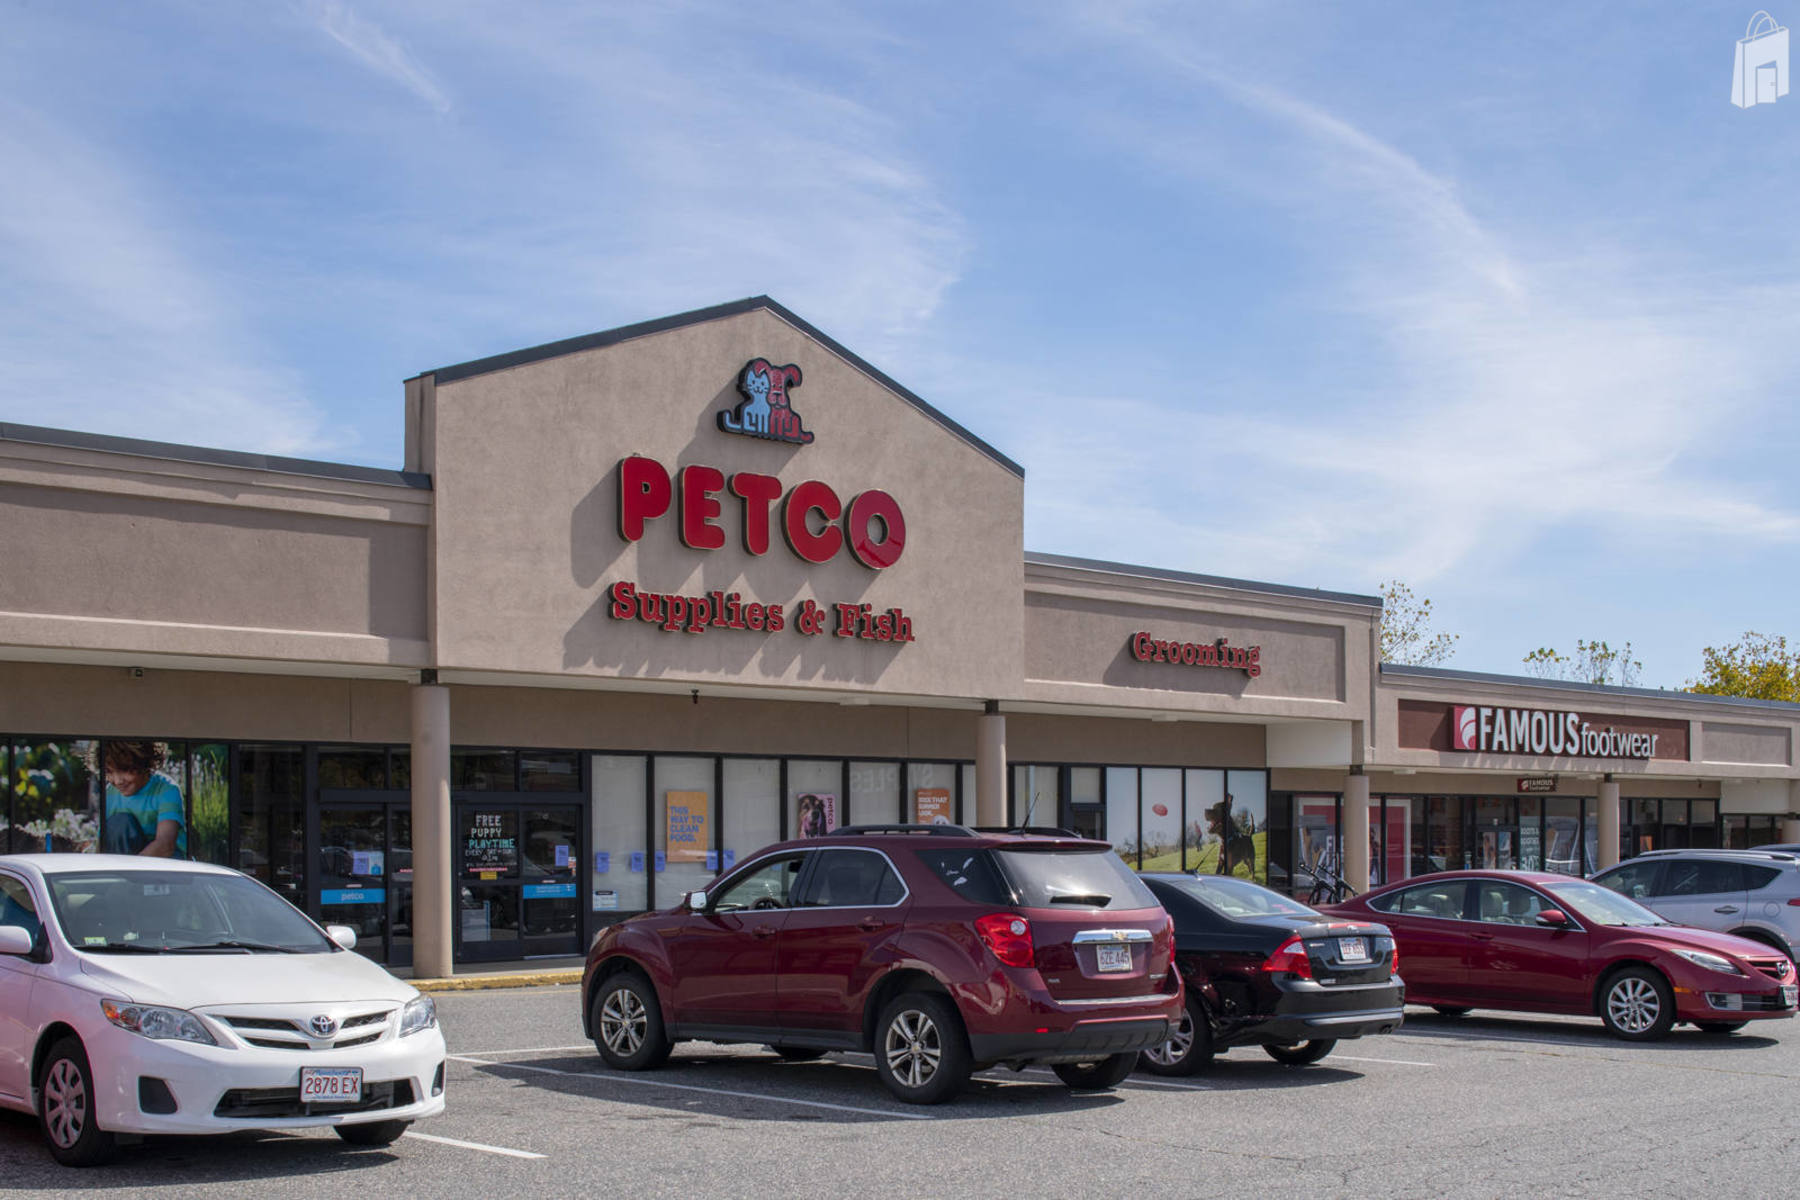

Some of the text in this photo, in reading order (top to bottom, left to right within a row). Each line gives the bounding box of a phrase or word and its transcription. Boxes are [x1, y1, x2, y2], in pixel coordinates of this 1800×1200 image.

[617, 455, 906, 570] PETCO
[608, 580, 916, 643] Supplies & Fish
[1129, 631, 1262, 678] Grooming
[1479, 707, 1659, 757] FAMOUS footwear
[670, 806, 689, 816] THIS
[475, 815, 502, 827] FREE
[670, 815, 704, 824] WAY TO
[471, 828, 502, 838] PUPPY
[670, 824, 699, 833] CLEAN
[670, 833, 696, 842] FOOD.
[469, 838, 516, 849] PLAYTIME
[341, 893, 365, 901] petco
[305, 1076, 359, 1094] 2878 EX
